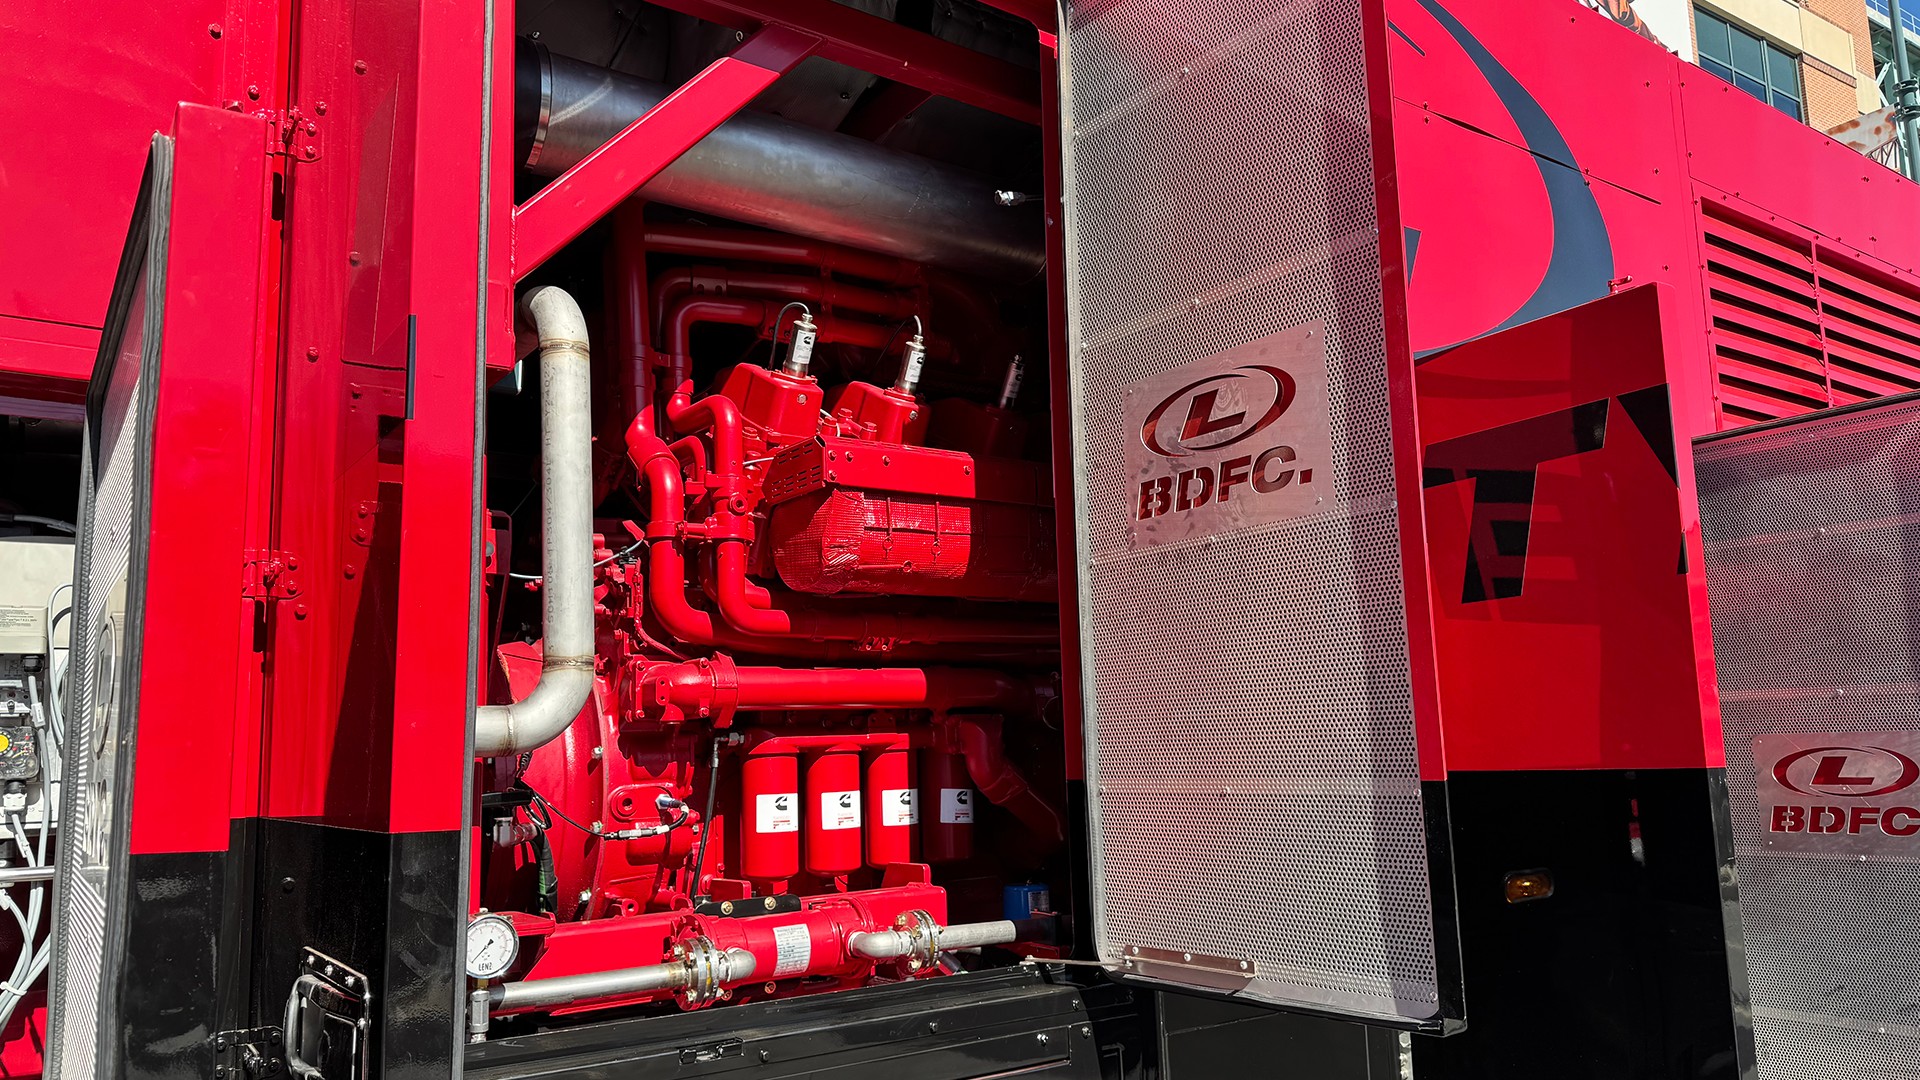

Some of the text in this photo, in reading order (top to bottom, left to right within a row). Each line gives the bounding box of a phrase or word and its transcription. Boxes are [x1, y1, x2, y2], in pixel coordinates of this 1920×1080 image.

[1178, 388, 1247, 442] L
[1136, 445, 1313, 521] BDFC.
[1809, 756, 1875, 786] L
[1769, 805, 1920, 838] BDFC
